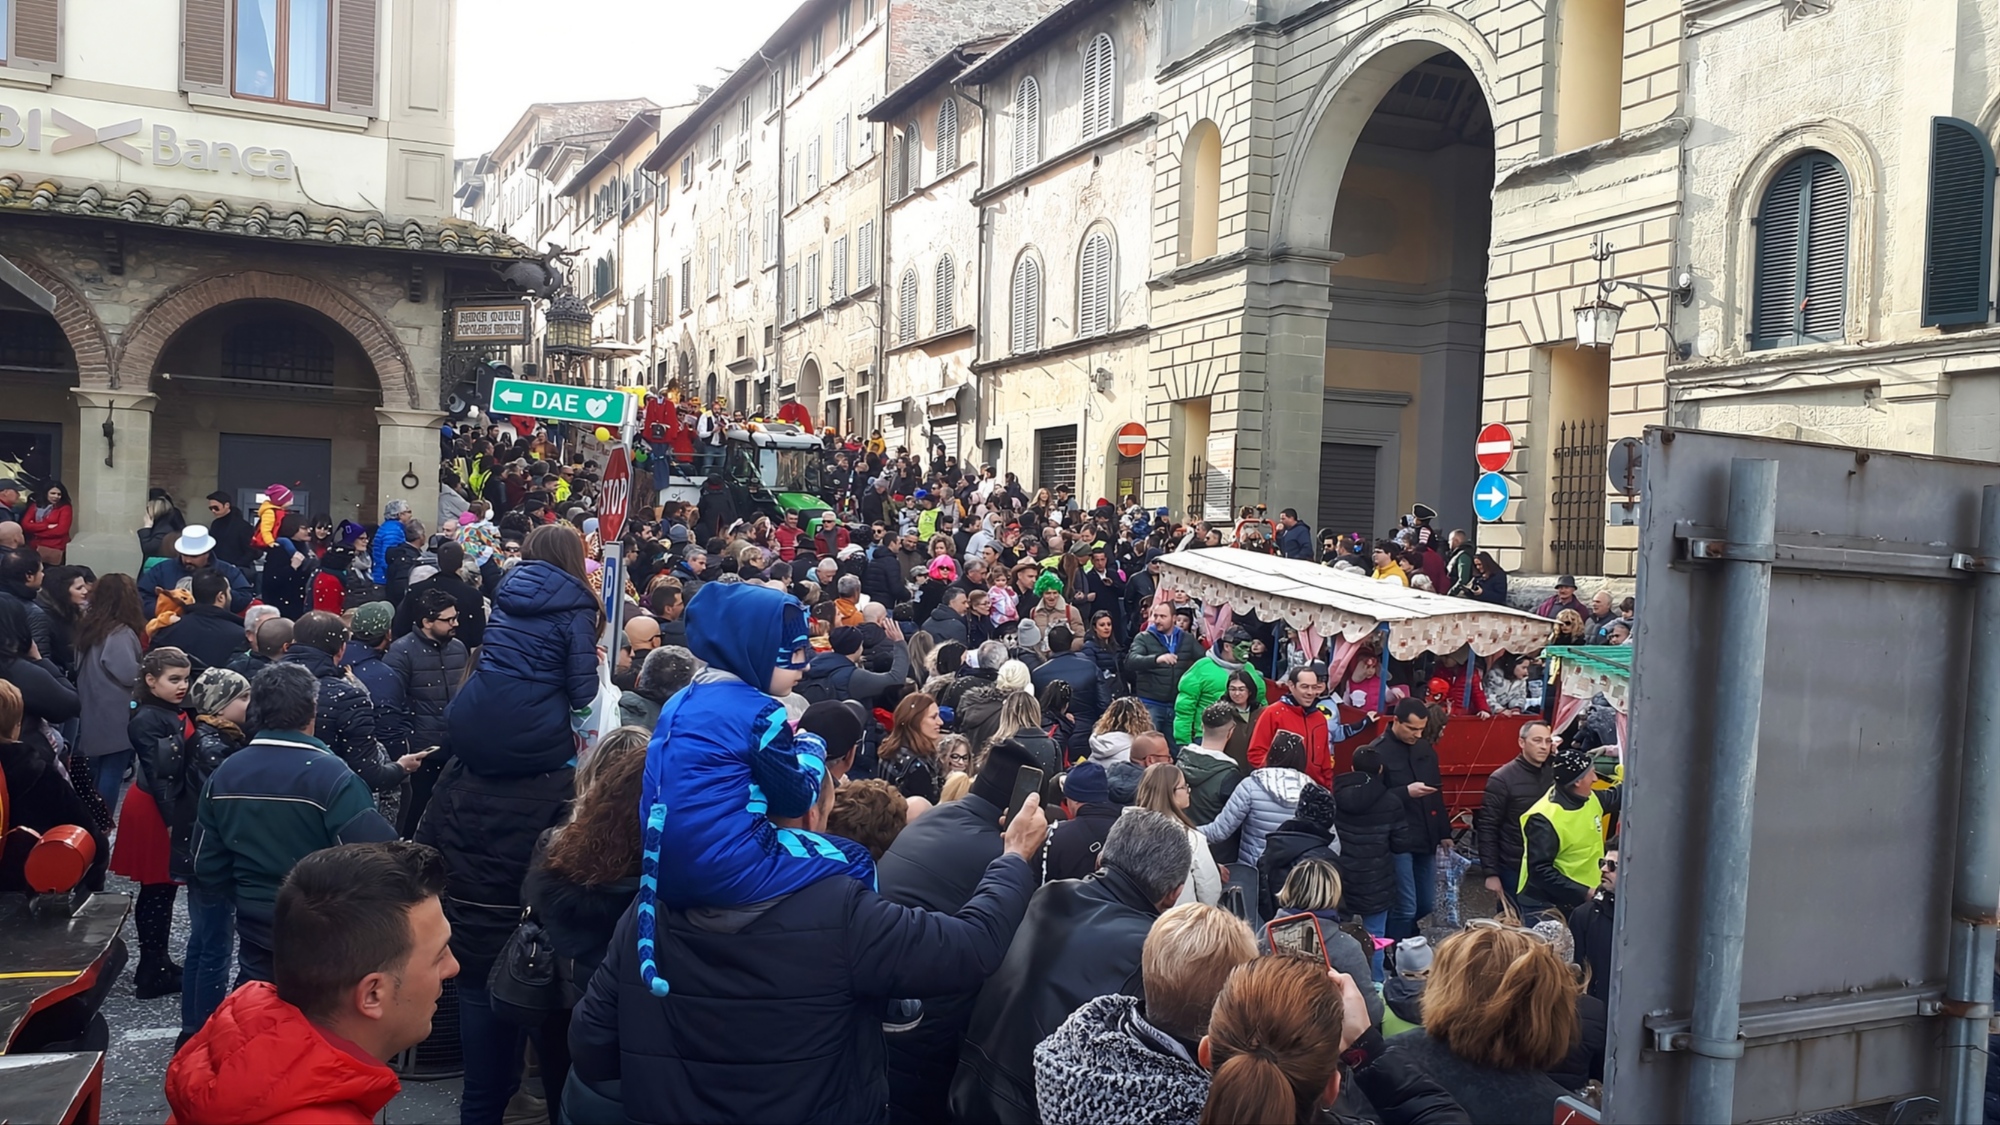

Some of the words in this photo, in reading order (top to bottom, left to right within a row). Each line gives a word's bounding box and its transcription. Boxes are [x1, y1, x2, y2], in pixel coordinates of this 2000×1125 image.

[152, 124, 292, 181] Banca
[532, 390, 580, 413] DAE
[600, 477, 628, 516] STOP
[603, 566, 614, 605] P
